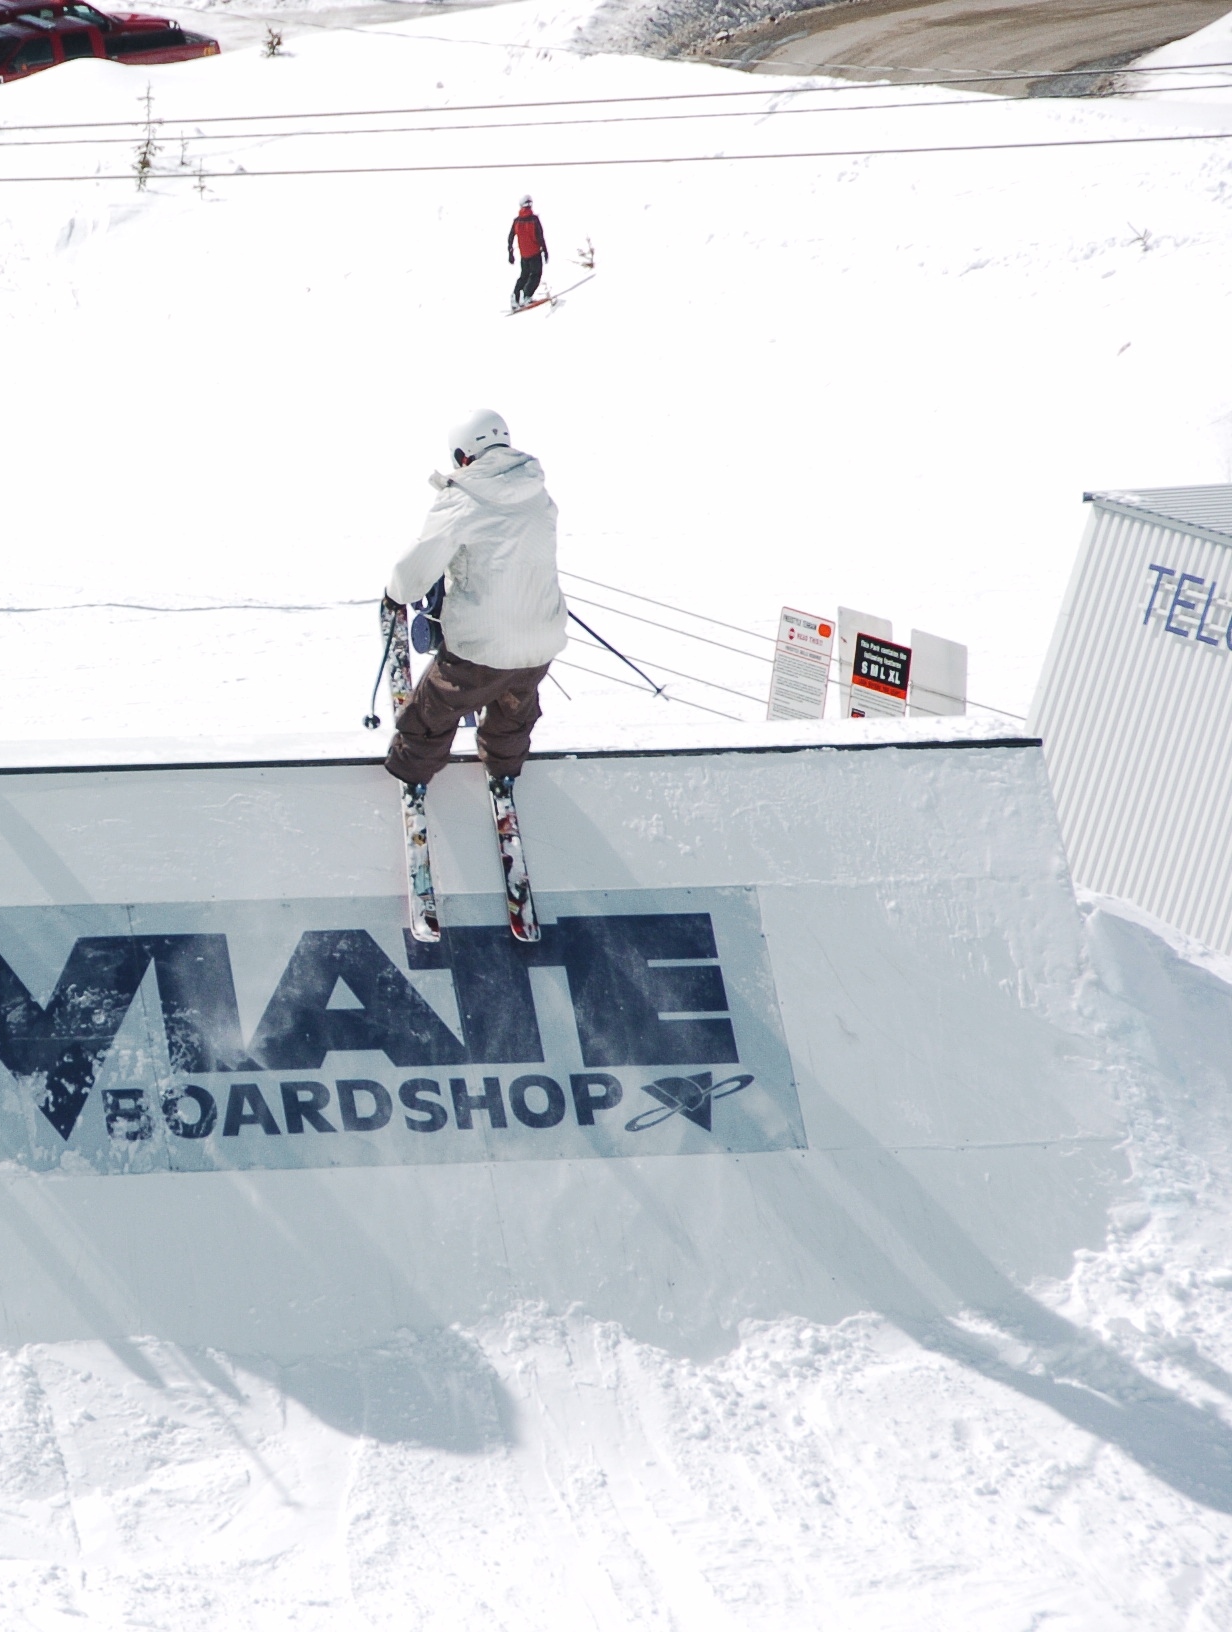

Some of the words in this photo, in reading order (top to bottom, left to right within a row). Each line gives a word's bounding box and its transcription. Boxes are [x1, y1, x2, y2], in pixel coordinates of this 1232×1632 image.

[861, 661, 868, 674] S
[870, 664, 878, 677] M
[880, 666, 886, 680] L
[888, 669, 901, 685] XL
[105, 1072, 624, 1140] BOARDSHOP
